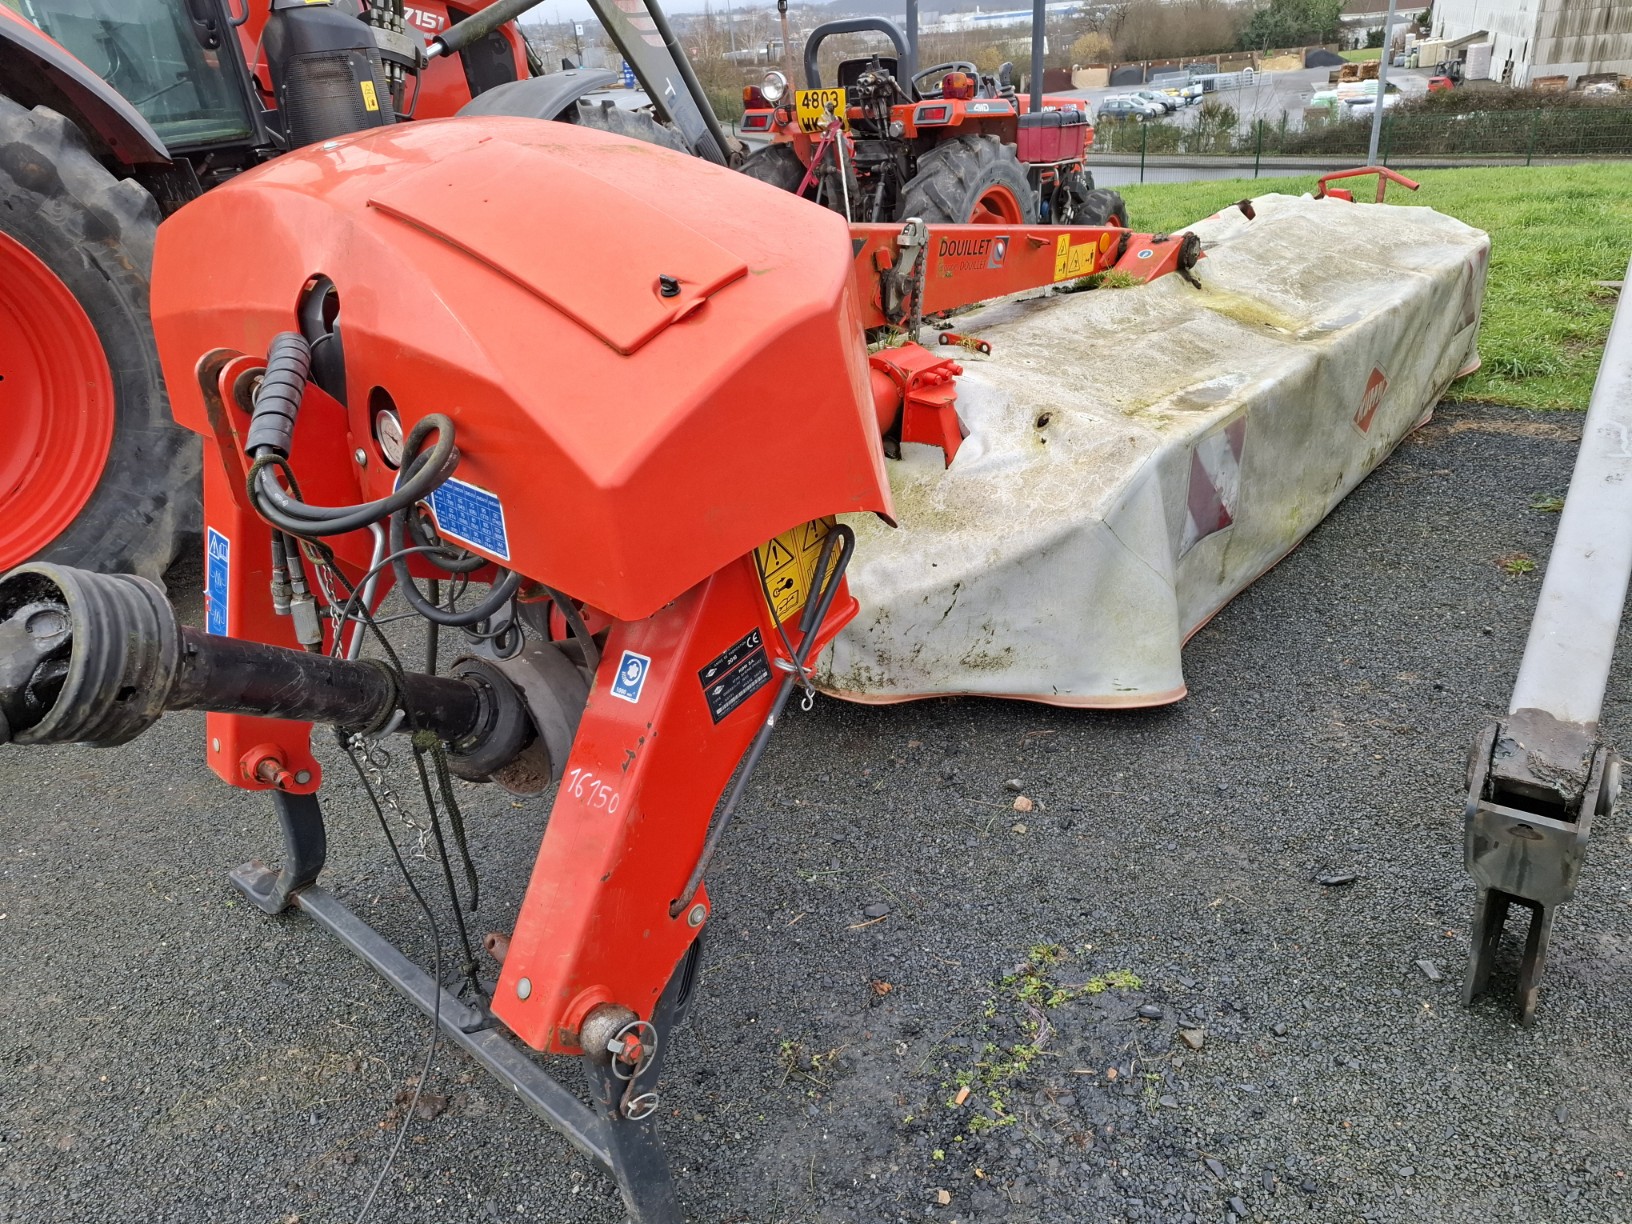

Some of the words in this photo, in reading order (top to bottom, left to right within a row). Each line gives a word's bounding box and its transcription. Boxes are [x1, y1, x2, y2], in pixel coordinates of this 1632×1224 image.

[801, 91, 839, 109] 4803
[973, 103, 990, 112] 4WD
[939, 239, 992, 257] DOUILLET
[567, 768, 620, 814] 16150
